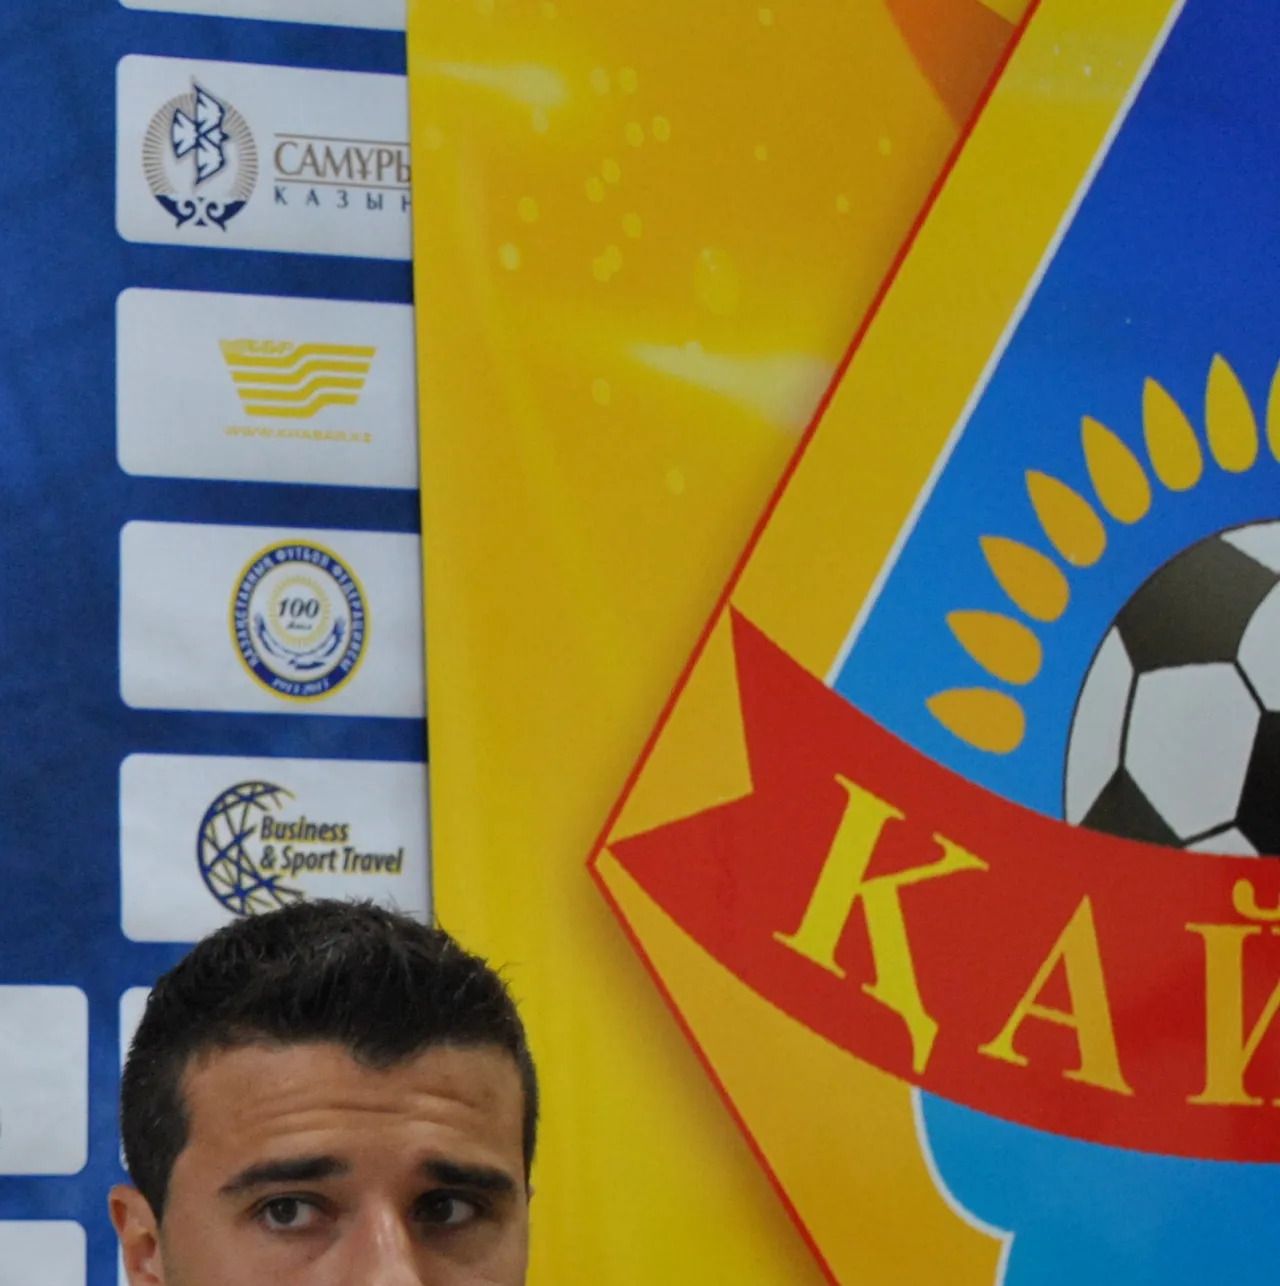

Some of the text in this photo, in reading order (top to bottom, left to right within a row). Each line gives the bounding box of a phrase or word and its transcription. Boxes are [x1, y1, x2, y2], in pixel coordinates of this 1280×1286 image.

[279, 597, 320, 619] 100
[260, 816, 349, 843] Business
[260, 845, 405, 878] & Sport Travel
